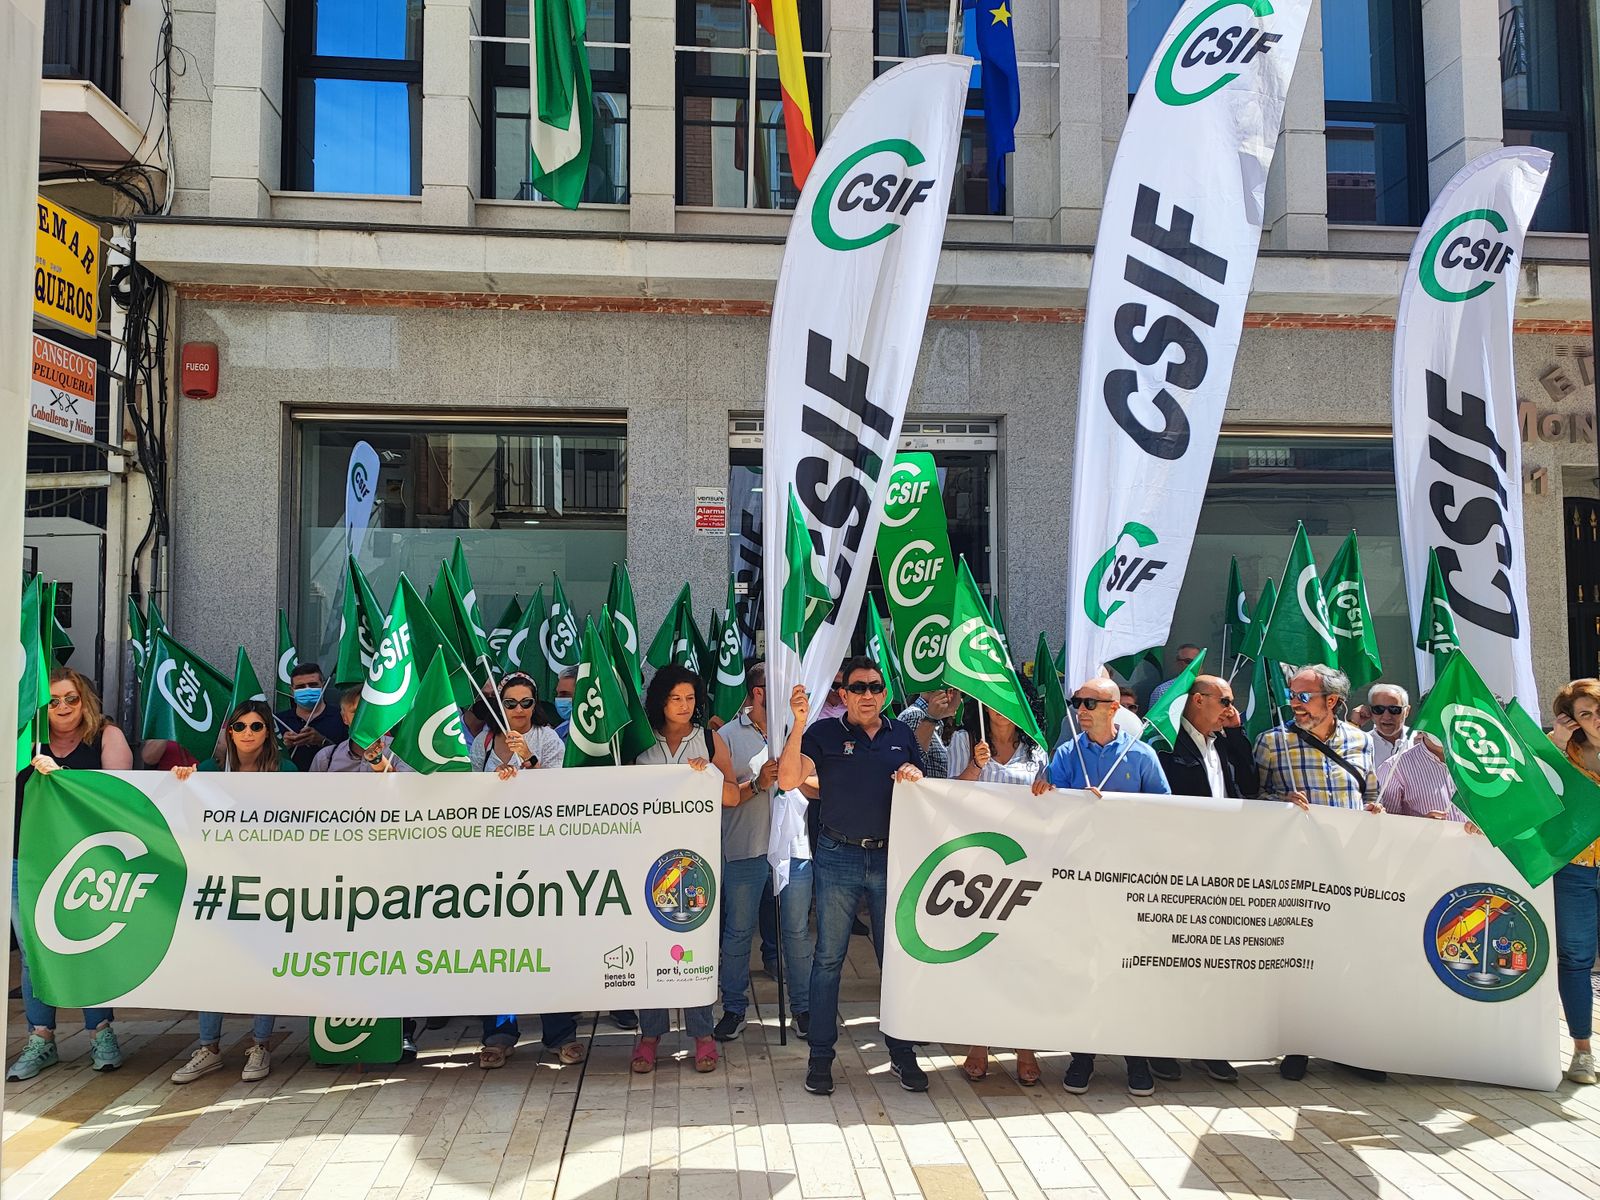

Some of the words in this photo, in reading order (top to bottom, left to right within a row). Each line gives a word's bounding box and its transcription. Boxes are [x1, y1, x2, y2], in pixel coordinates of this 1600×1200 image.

[1180, 26, 1283, 68] CSIF
[838, 171, 937, 216] CSIF
[37, 203, 95, 275] EMAR
[1440, 236, 1514, 275] CSIF
[34, 267, 93, 323] QUEROS
[1103, 183, 1229, 461] CSIF
[33, 362, 93, 396] PELUQUERIA
[185, 362, 210, 372] FUEGO
[31, 404, 69, 428] Caballeros
[69, 420, 75, 433] y
[75, 418, 93, 436] Niños
[886, 480, 930, 505] CSIF
[1425, 369, 1519, 640] CSIF
[900, 557, 944, 585] CSIF
[1106, 554, 1168, 592] SIF
[369, 622, 411, 682] CSIF
[176, 660, 201, 714] CSIF
[1455, 720, 1523, 783] CSIF
[203, 810, 236, 823] POR
[240, 810, 259, 823] LA
[263, 807, 376, 823] DIGNIFICACIÓN
[380, 810, 400, 823] DE
[405, 809, 423, 822] LA
[428, 807, 478, 821] LABOR
[481, 807, 500, 820] DE
[504, 805, 553, 819] LOS/AS
[556, 802, 639, 818] EMPLEADOS
[643, 798, 714, 815] PÚBLICOS
[201, 829, 211, 842] Y
[215, 829, 234, 842] LA
[238, 829, 305, 842] CALIDAD
[309, 829, 330, 842] DE
[334, 829, 364, 842] LOS
[367, 826, 448, 842] SERVICIOS
[451, 825, 482, 839] QUE
[485, 824, 535, 838] RECIBE
[539, 823, 556, 837] LA
[559, 818, 642, 836] CIUDADANÍA
[63, 867, 160, 914] CSIF
[193, 869, 632, 933] #EquiparaciónYA
[925, 869, 1043, 922] CSIF
[1052, 868, 1075, 880] POR
[1078, 870, 1092, 881] LA
[1094, 871, 1168, 885] DIGNIFICACIÓN
[1170, 875, 1184, 886] DE
[1186, 875, 1199, 887] LA
[1201, 876, 1235, 888] LABOR
[1237, 878, 1250, 889] DE
[1252, 878, 1290, 890] LAS/LOS
[1291, 879, 1352, 896] EMPLEADOS
[1354, 886, 1406, 902] PÚBLICOS
[1126, 892, 1145, 902] POR
[1147, 893, 1159, 903] LA
[1161, 894, 1227, 906] RECUPERACIÓN
[1229, 896, 1246, 907] DEL
[1249, 897, 1277, 908] PODER
[1278, 898, 1331, 912] ADQUISITIVO
[1137, 912, 1174, 923] MEJORA
[1176, 914, 1188, 924] DE
[1190, 914, 1207, 925] LAS
[1209, 915, 1267, 926] CONDICIONES
[1268, 916, 1314, 928] LABORALES
[1171, 934, 1208, 945] MEJORA
[1210, 935, 1222, 945] DE
[1224, 936, 1240, 946] LAS
[1242, 936, 1285, 946] PENSIONES
[272, 950, 407, 977] JUSTICIA
[416, 948, 550, 974] SALARIAL
[604, 973, 626, 981] tienes
[628, 972, 635, 980] la
[656, 967, 671, 976] por
[673, 966, 681, 976] ti,
[683, 965, 714, 976] contigo
[1121, 955, 1201, 969] ¡¡¡DEFENDEMOS
[1203, 957, 1257, 970] NUESTROS
[1258, 957, 1314, 970] DERECHOS!!!
[604, 980, 635, 989] palabra
